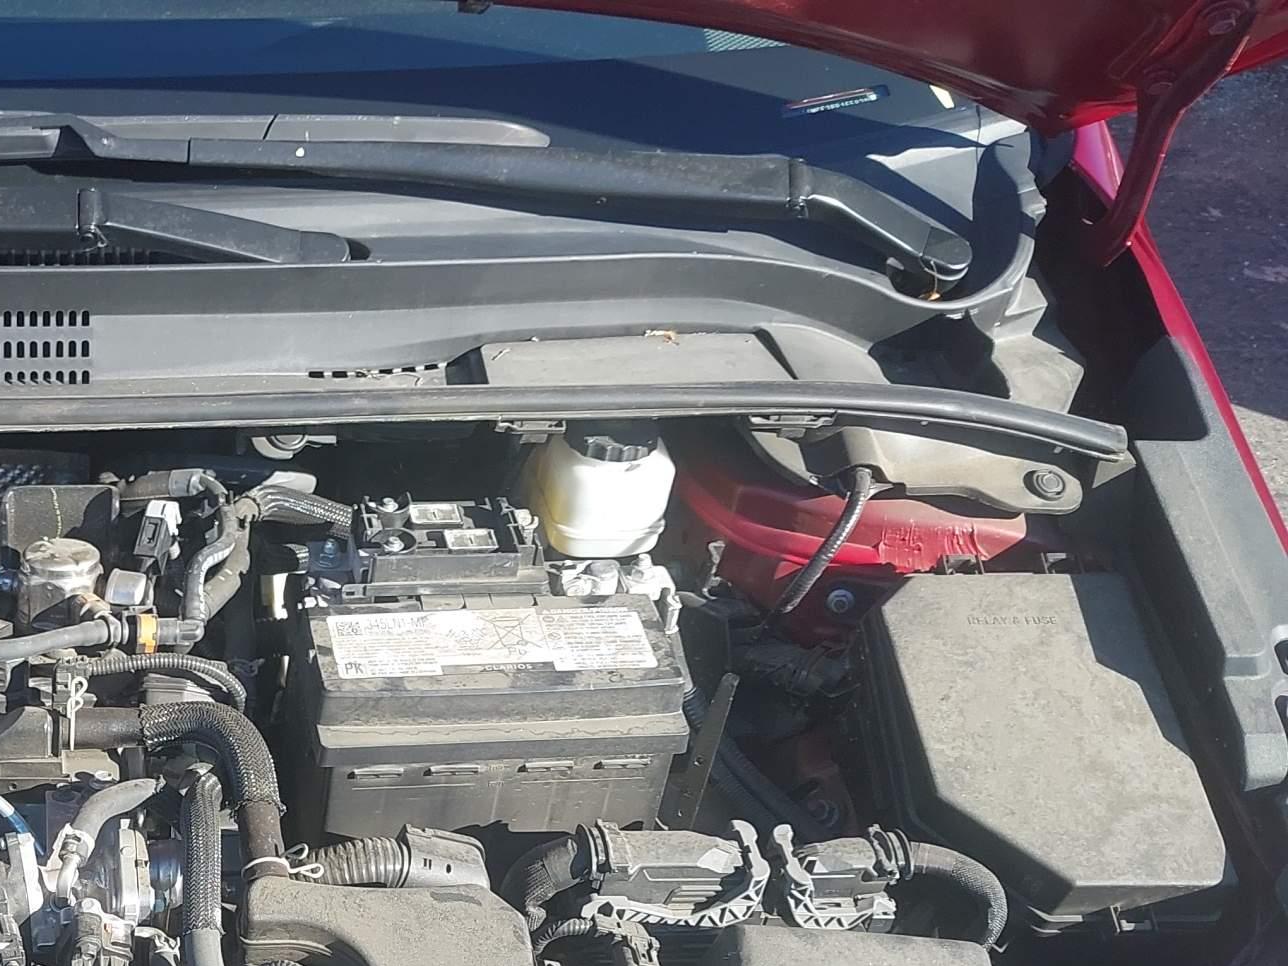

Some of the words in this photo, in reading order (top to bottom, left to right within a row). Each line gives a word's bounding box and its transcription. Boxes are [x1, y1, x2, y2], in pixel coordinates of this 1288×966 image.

[1024, 615, 1057, 625] FUSE
[344, 661, 364, 675] PK
[485, 663, 533, 671] CLARIOS
